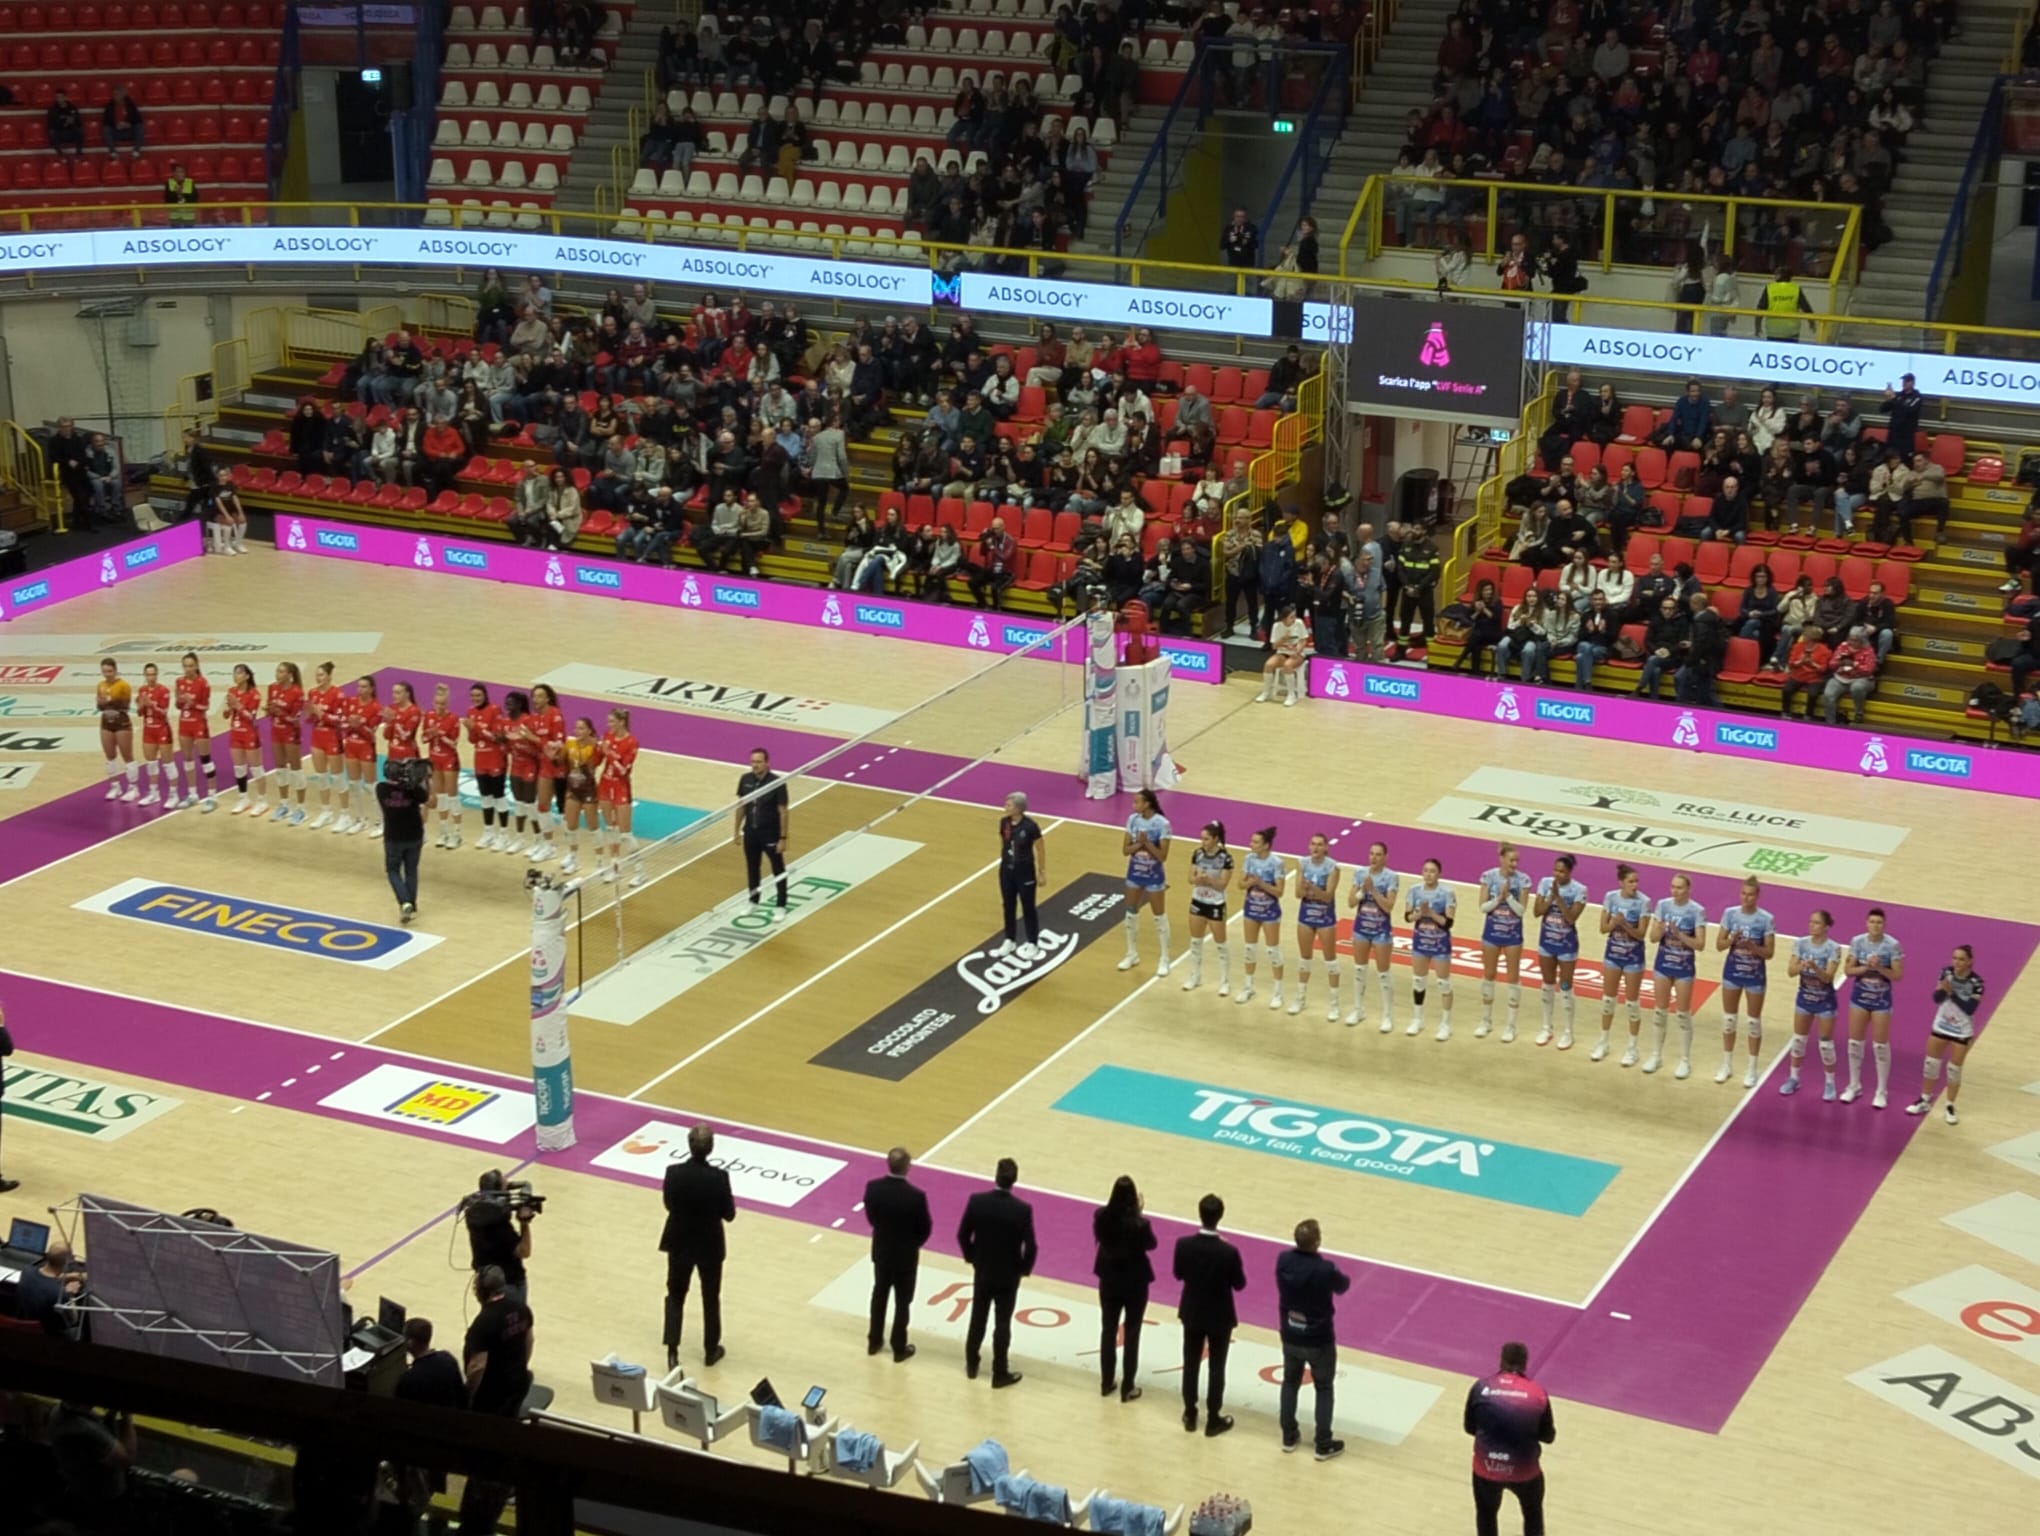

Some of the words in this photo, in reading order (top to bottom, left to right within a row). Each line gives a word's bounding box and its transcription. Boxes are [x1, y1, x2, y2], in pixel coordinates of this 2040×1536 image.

[123, 238, 227, 254] ABSOLOGY
[273, 237, 374, 252] ABSOLOGY
[418, 239, 514, 256] ABSOLOGY
[555, 246, 643, 267] ABSOLOGY
[681, 257, 770, 279] ABSOLOGY
[810, 269, 902, 291] ABSOLOGY
[988, 285, 1085, 308] ABSOLOGY
[1128, 298, 1228, 321] ABSOLOGY
[1583, 337, 1697, 361] ABSOLOGY
[1749, 352, 1869, 377] ABSOLOGY
[1379, 375, 1408, 387] Scarica
[617, 676, 796, 716] ARVAL
[1469, 803, 1680, 849] Rigydo
[1676, 802, 1717, 816] RG
[1729, 810, 1807, 829] LUCE
[136, 893, 379, 951] FINECO
[867, 1008, 938, 1054] CIOCCOLATO
[886, 1012, 956, 1057] PIEMONTESE
[2, 1065, 160, 1120] ITAS
[412, 1092, 471, 1111] MD
[1213, 1127, 1262, 1146] play
[1265, 1136, 1303, 1154] fair,
[1309, 1145, 1352, 1163] feel
[1353, 1156, 1415, 1176] good
